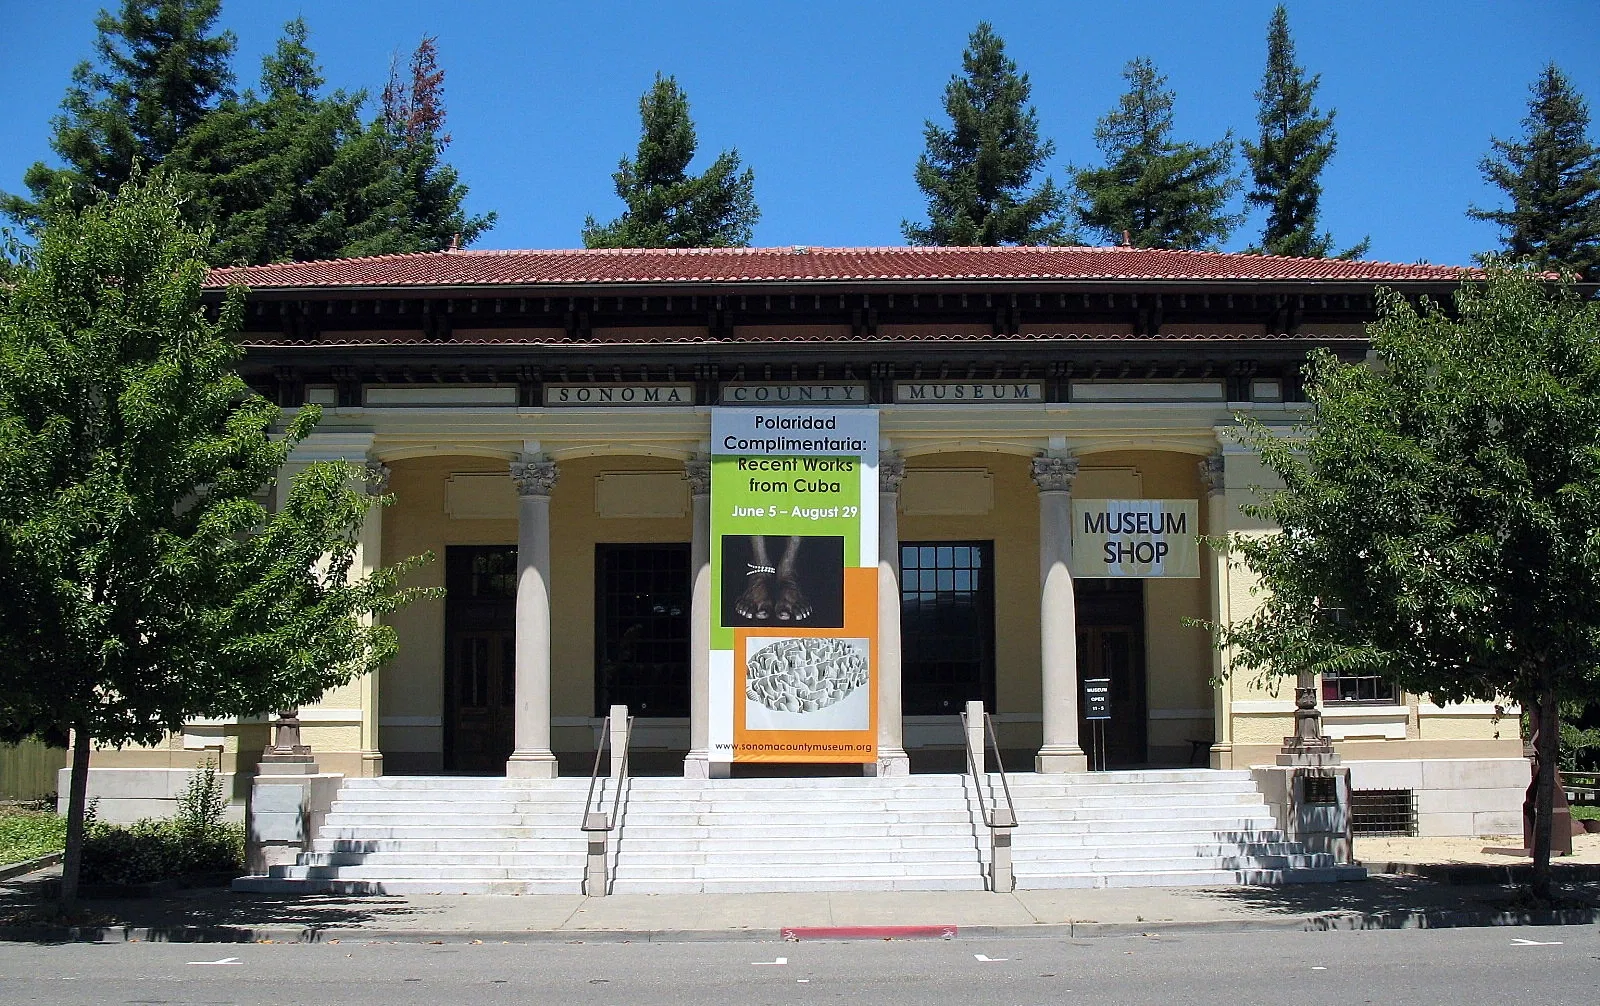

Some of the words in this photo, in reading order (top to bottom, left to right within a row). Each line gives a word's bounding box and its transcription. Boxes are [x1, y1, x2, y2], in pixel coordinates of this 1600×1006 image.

[559, 388, 682, 402] SONOMA
[734, 387, 854, 400] COUNTY
[910, 385, 1030, 399] MUSEUM
[755, 415, 837, 430] Polaridad
[724, 436, 867, 453] Complimentaria:
[738, 458, 798, 471] Recent
[803, 458, 854, 472] Works
[749, 478, 788, 493] from
[793, 479, 841, 493] Cuba
[731, 506, 765, 517] June
[768, 506, 777, 517] 5
[791, 506, 838, 520] August
[842, 507, 858, 518] 29
[1084, 512, 1187, 534] MUSEUM
[1103, 542, 1169, 564] SHOP
[715, 743, 872, 752] www.sonomacountymuseum.org
